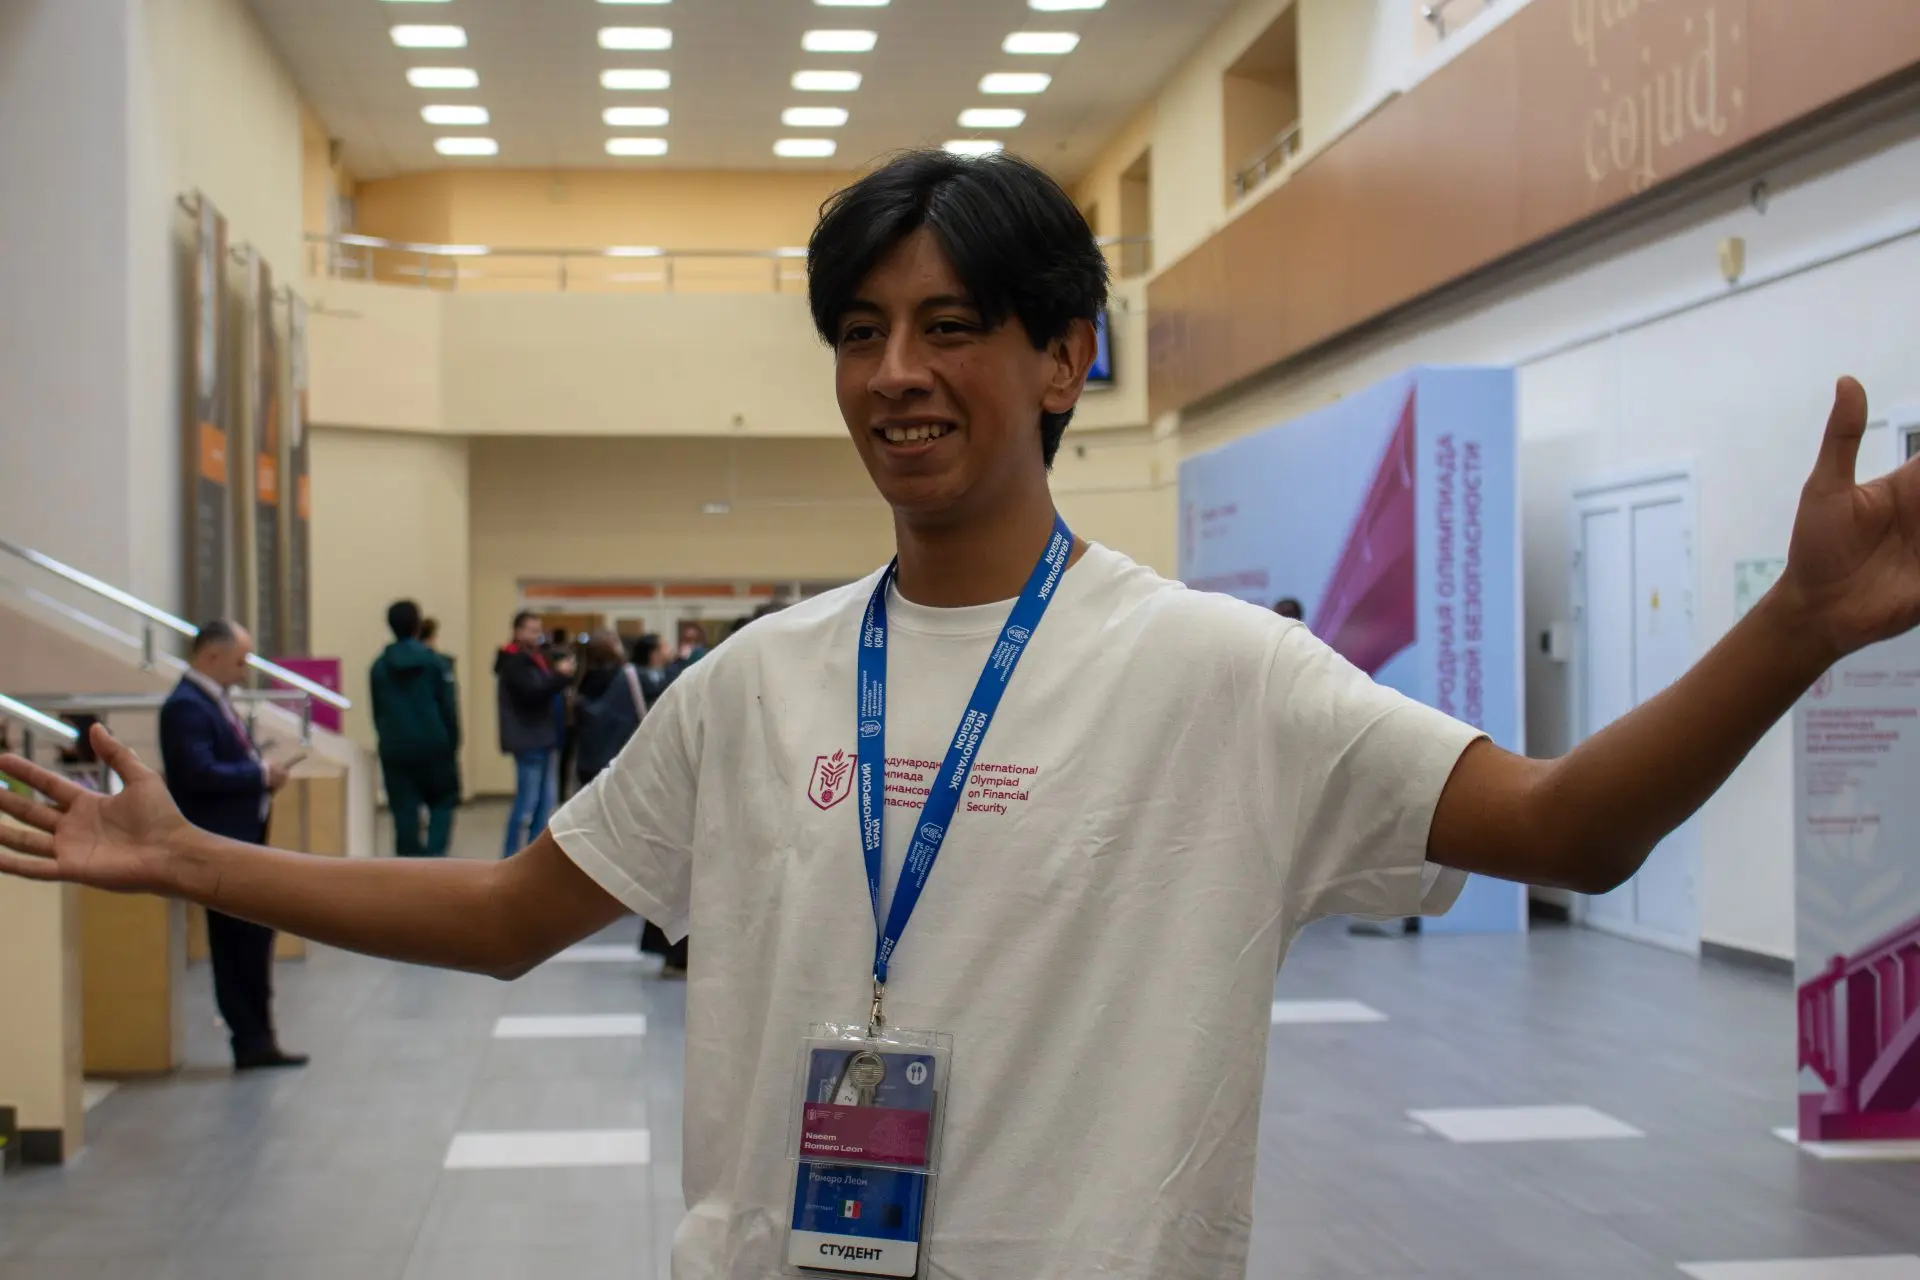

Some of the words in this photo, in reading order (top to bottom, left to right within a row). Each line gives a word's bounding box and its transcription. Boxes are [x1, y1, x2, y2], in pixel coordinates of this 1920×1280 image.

[1435, 433, 1457, 599] ОЛИМПИАДА
[1045, 531, 1062, 563] REGION
[1463, 441, 1483, 641] БЕЗОПАСНОСТИ
[1038, 538, 1069, 600] KRASNOYARSK
[874, 627, 884, 648] КРАЙ
[954, 709, 978, 750] REGION
[948, 712, 988, 791] KRASNOYARSK
[884, 772, 924, 782] мпиада
[973, 762, 1039, 775] International
[970, 775, 1020, 788] Olympiad
[968, 790, 980, 798] on
[982, 789, 1029, 801] Financial
[861, 763, 873, 851] КРАСНОЯРСКИЙ
[966, 802, 1008, 815] Security
[872, 818, 881, 849] КРАЙ
[805, 1131, 837, 1141] Naeem
[804, 1142, 839, 1152] Romero
[840, 1145, 863, 1153] Leon
[809, 1172, 842, 1184] Ромеро
[844, 1175, 868, 1186] Леон
[819, 1243, 883, 1260] СТУДЕНТ
